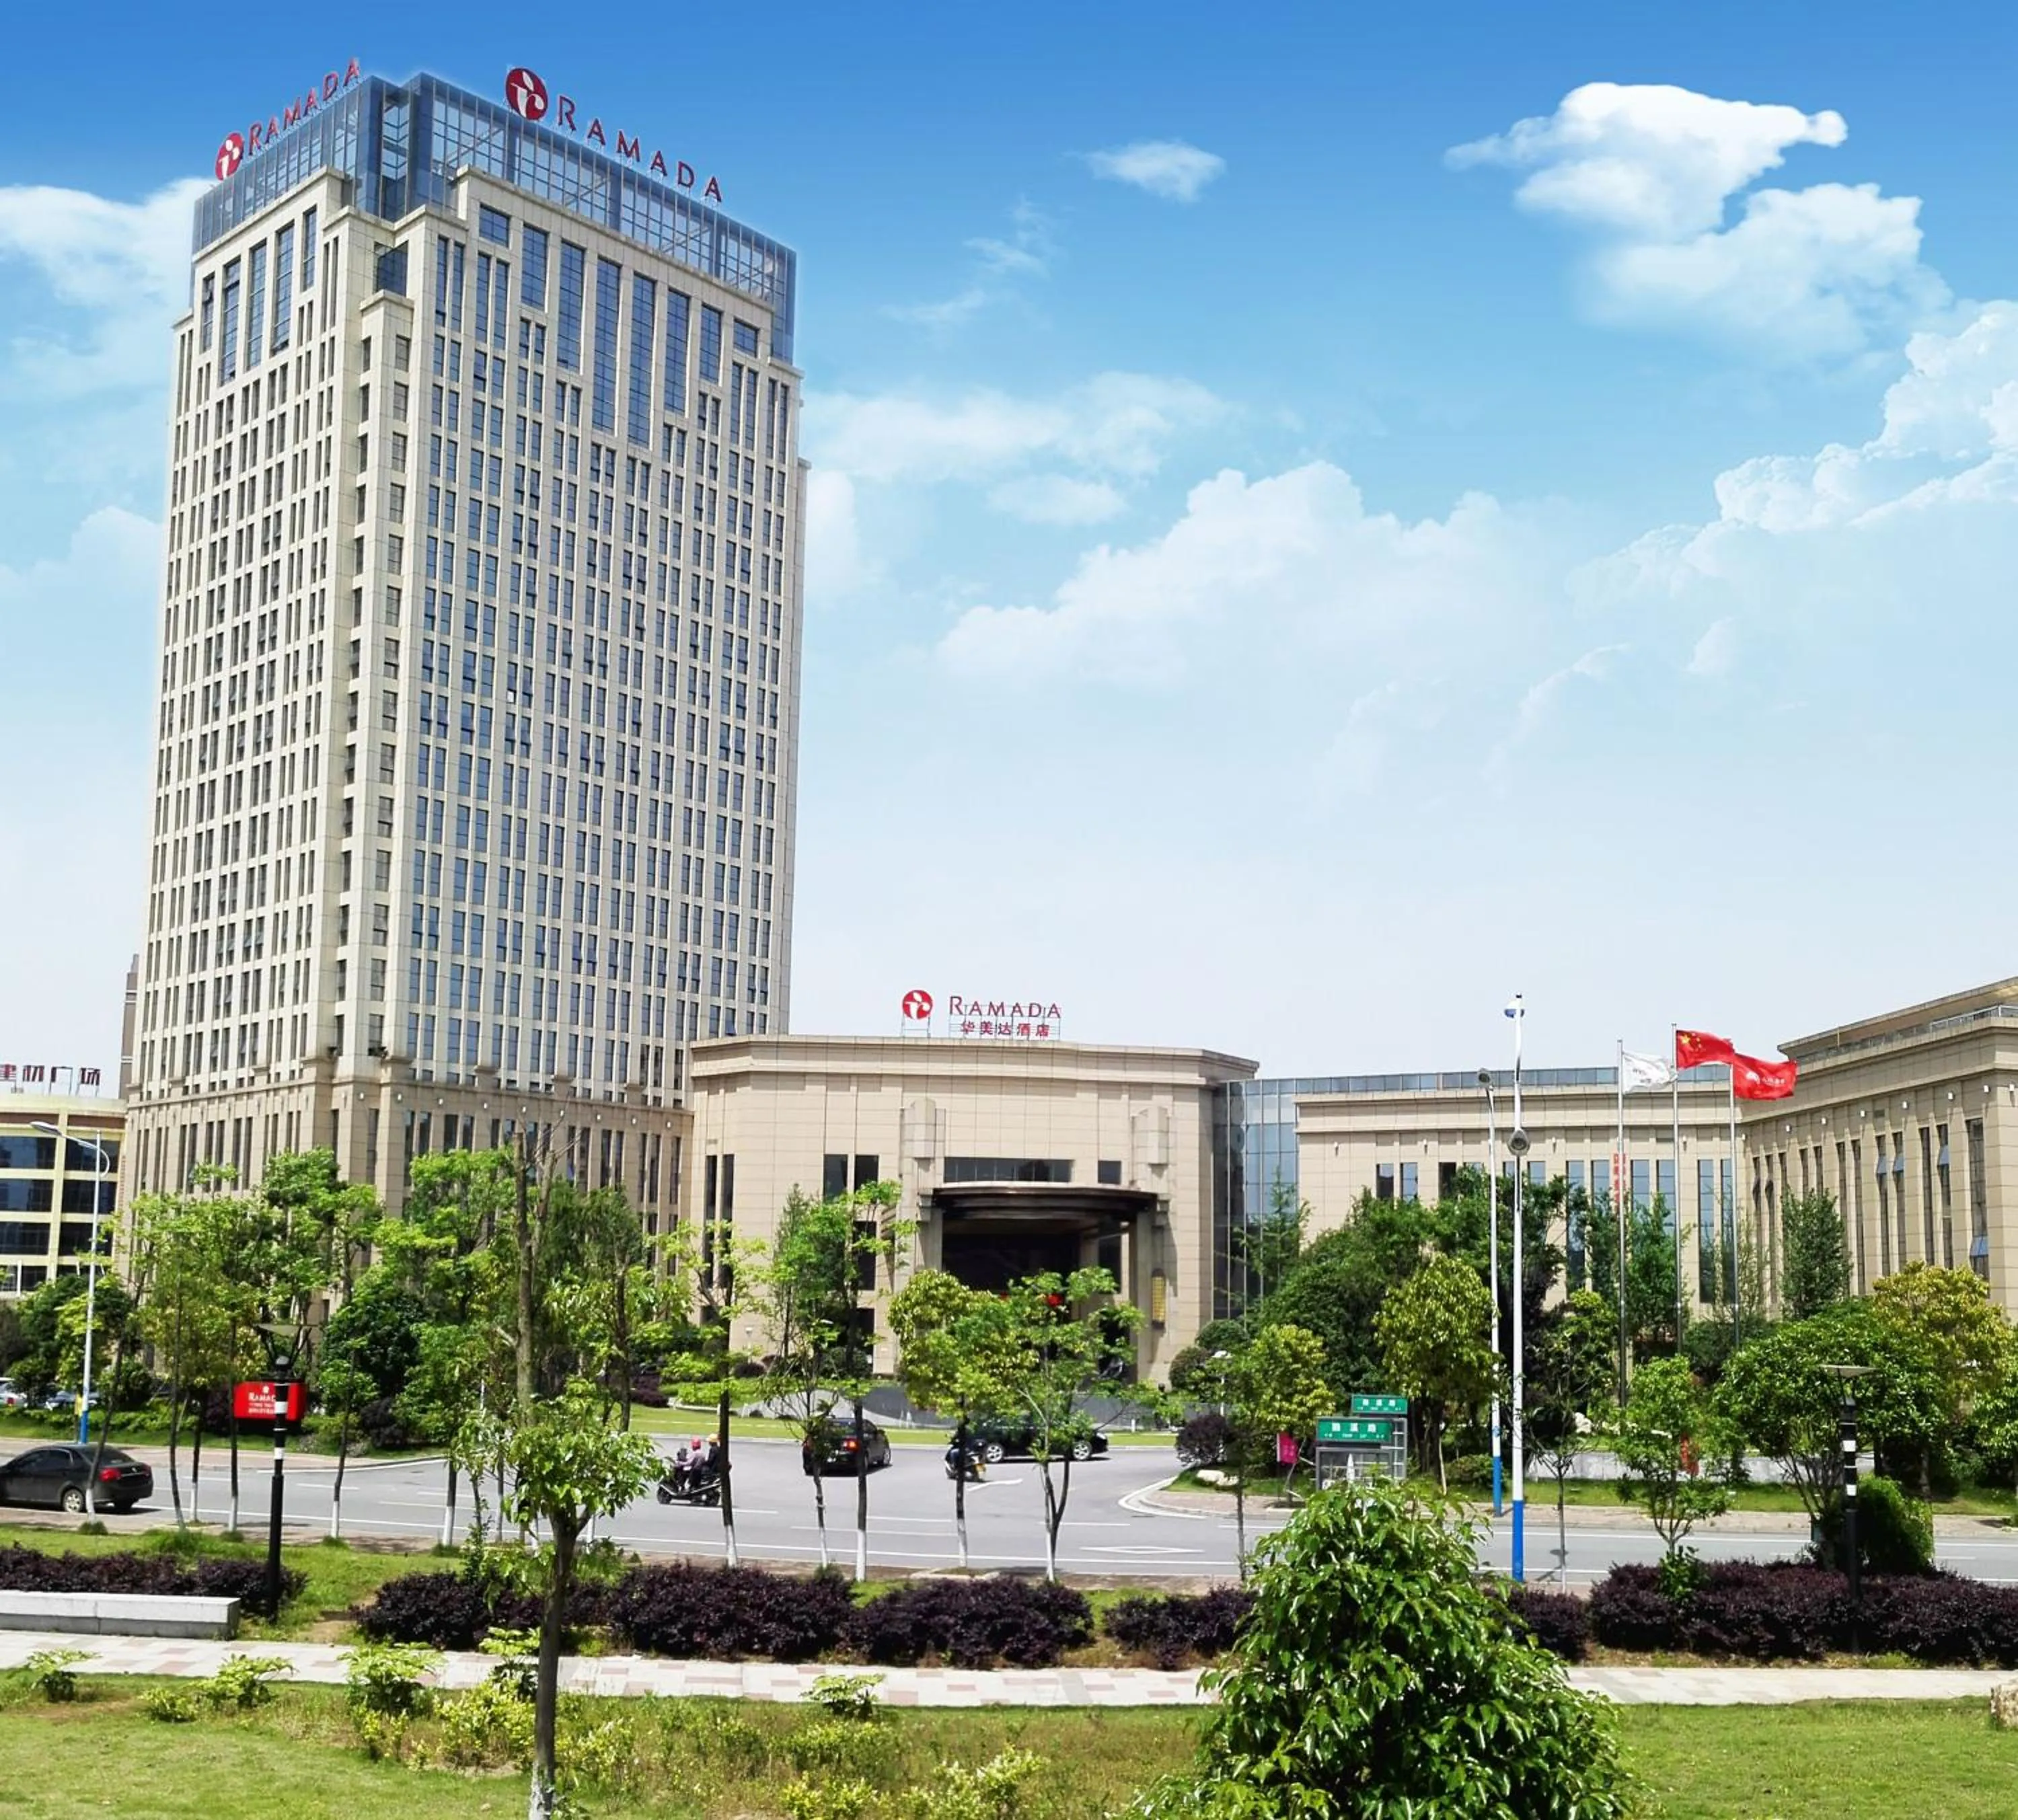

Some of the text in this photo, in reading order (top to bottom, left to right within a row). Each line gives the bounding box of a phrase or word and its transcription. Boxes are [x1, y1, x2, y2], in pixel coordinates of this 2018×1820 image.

[248, 57, 361, 156] RAMADA
[558, 95, 722, 202] RAMADA
[949, 995, 1061, 1018] RAMADA
[961, 1021, 1050, 1036] 华美达酒店
